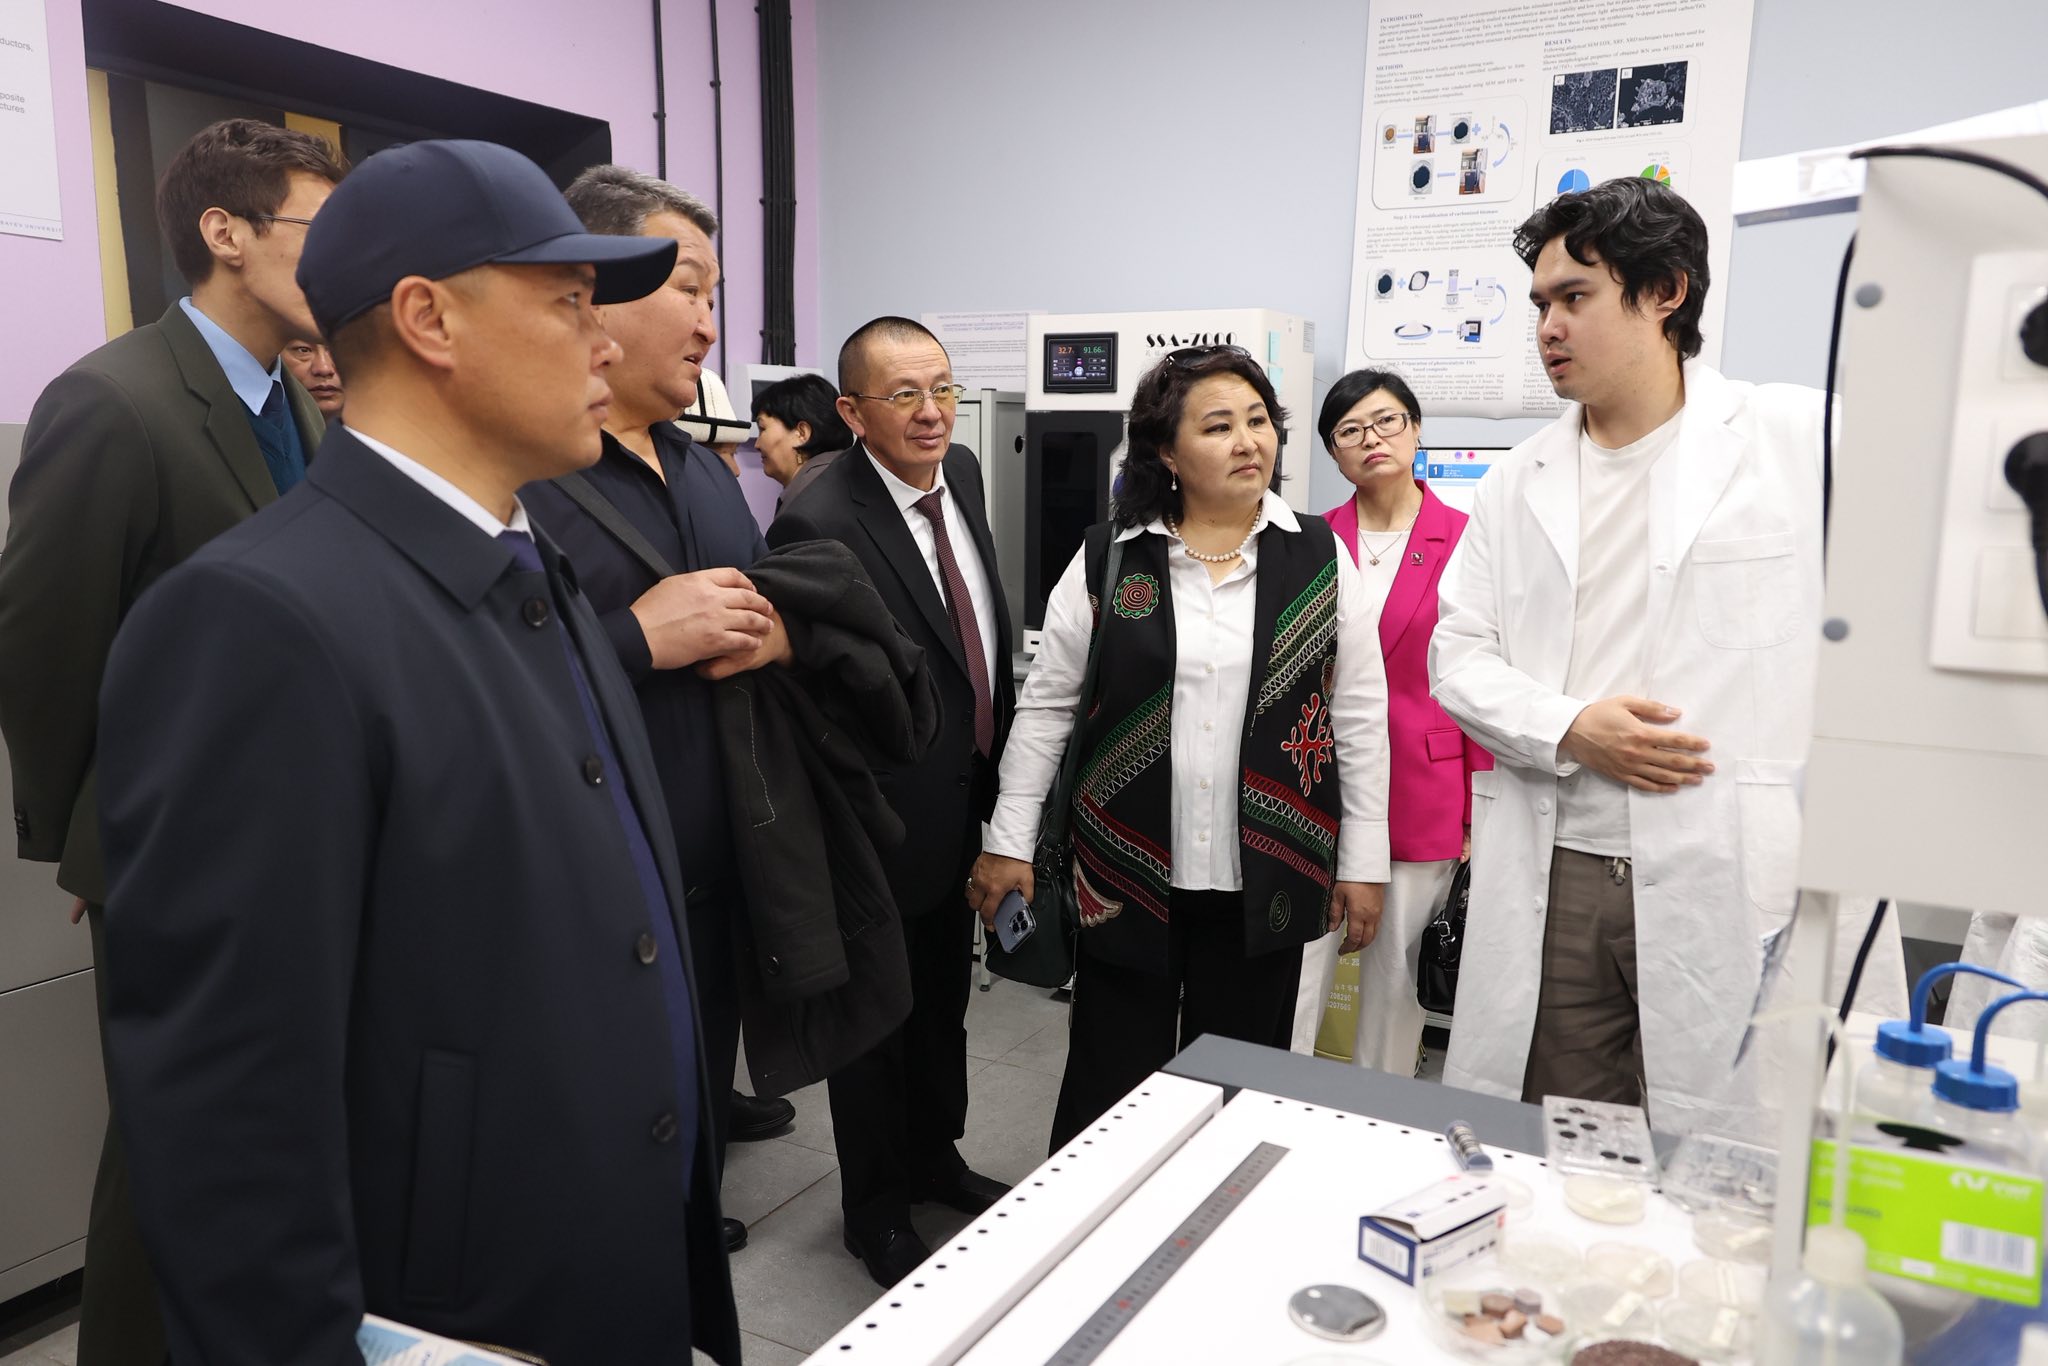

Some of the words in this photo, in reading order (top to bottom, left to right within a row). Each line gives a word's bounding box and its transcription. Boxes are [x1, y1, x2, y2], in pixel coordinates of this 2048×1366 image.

[1380, 13, 1423, 23] INTRODUCTION
[1146, 332, 1237, 347] SSA-7000
[1433, 466, 1438, 475] 1
